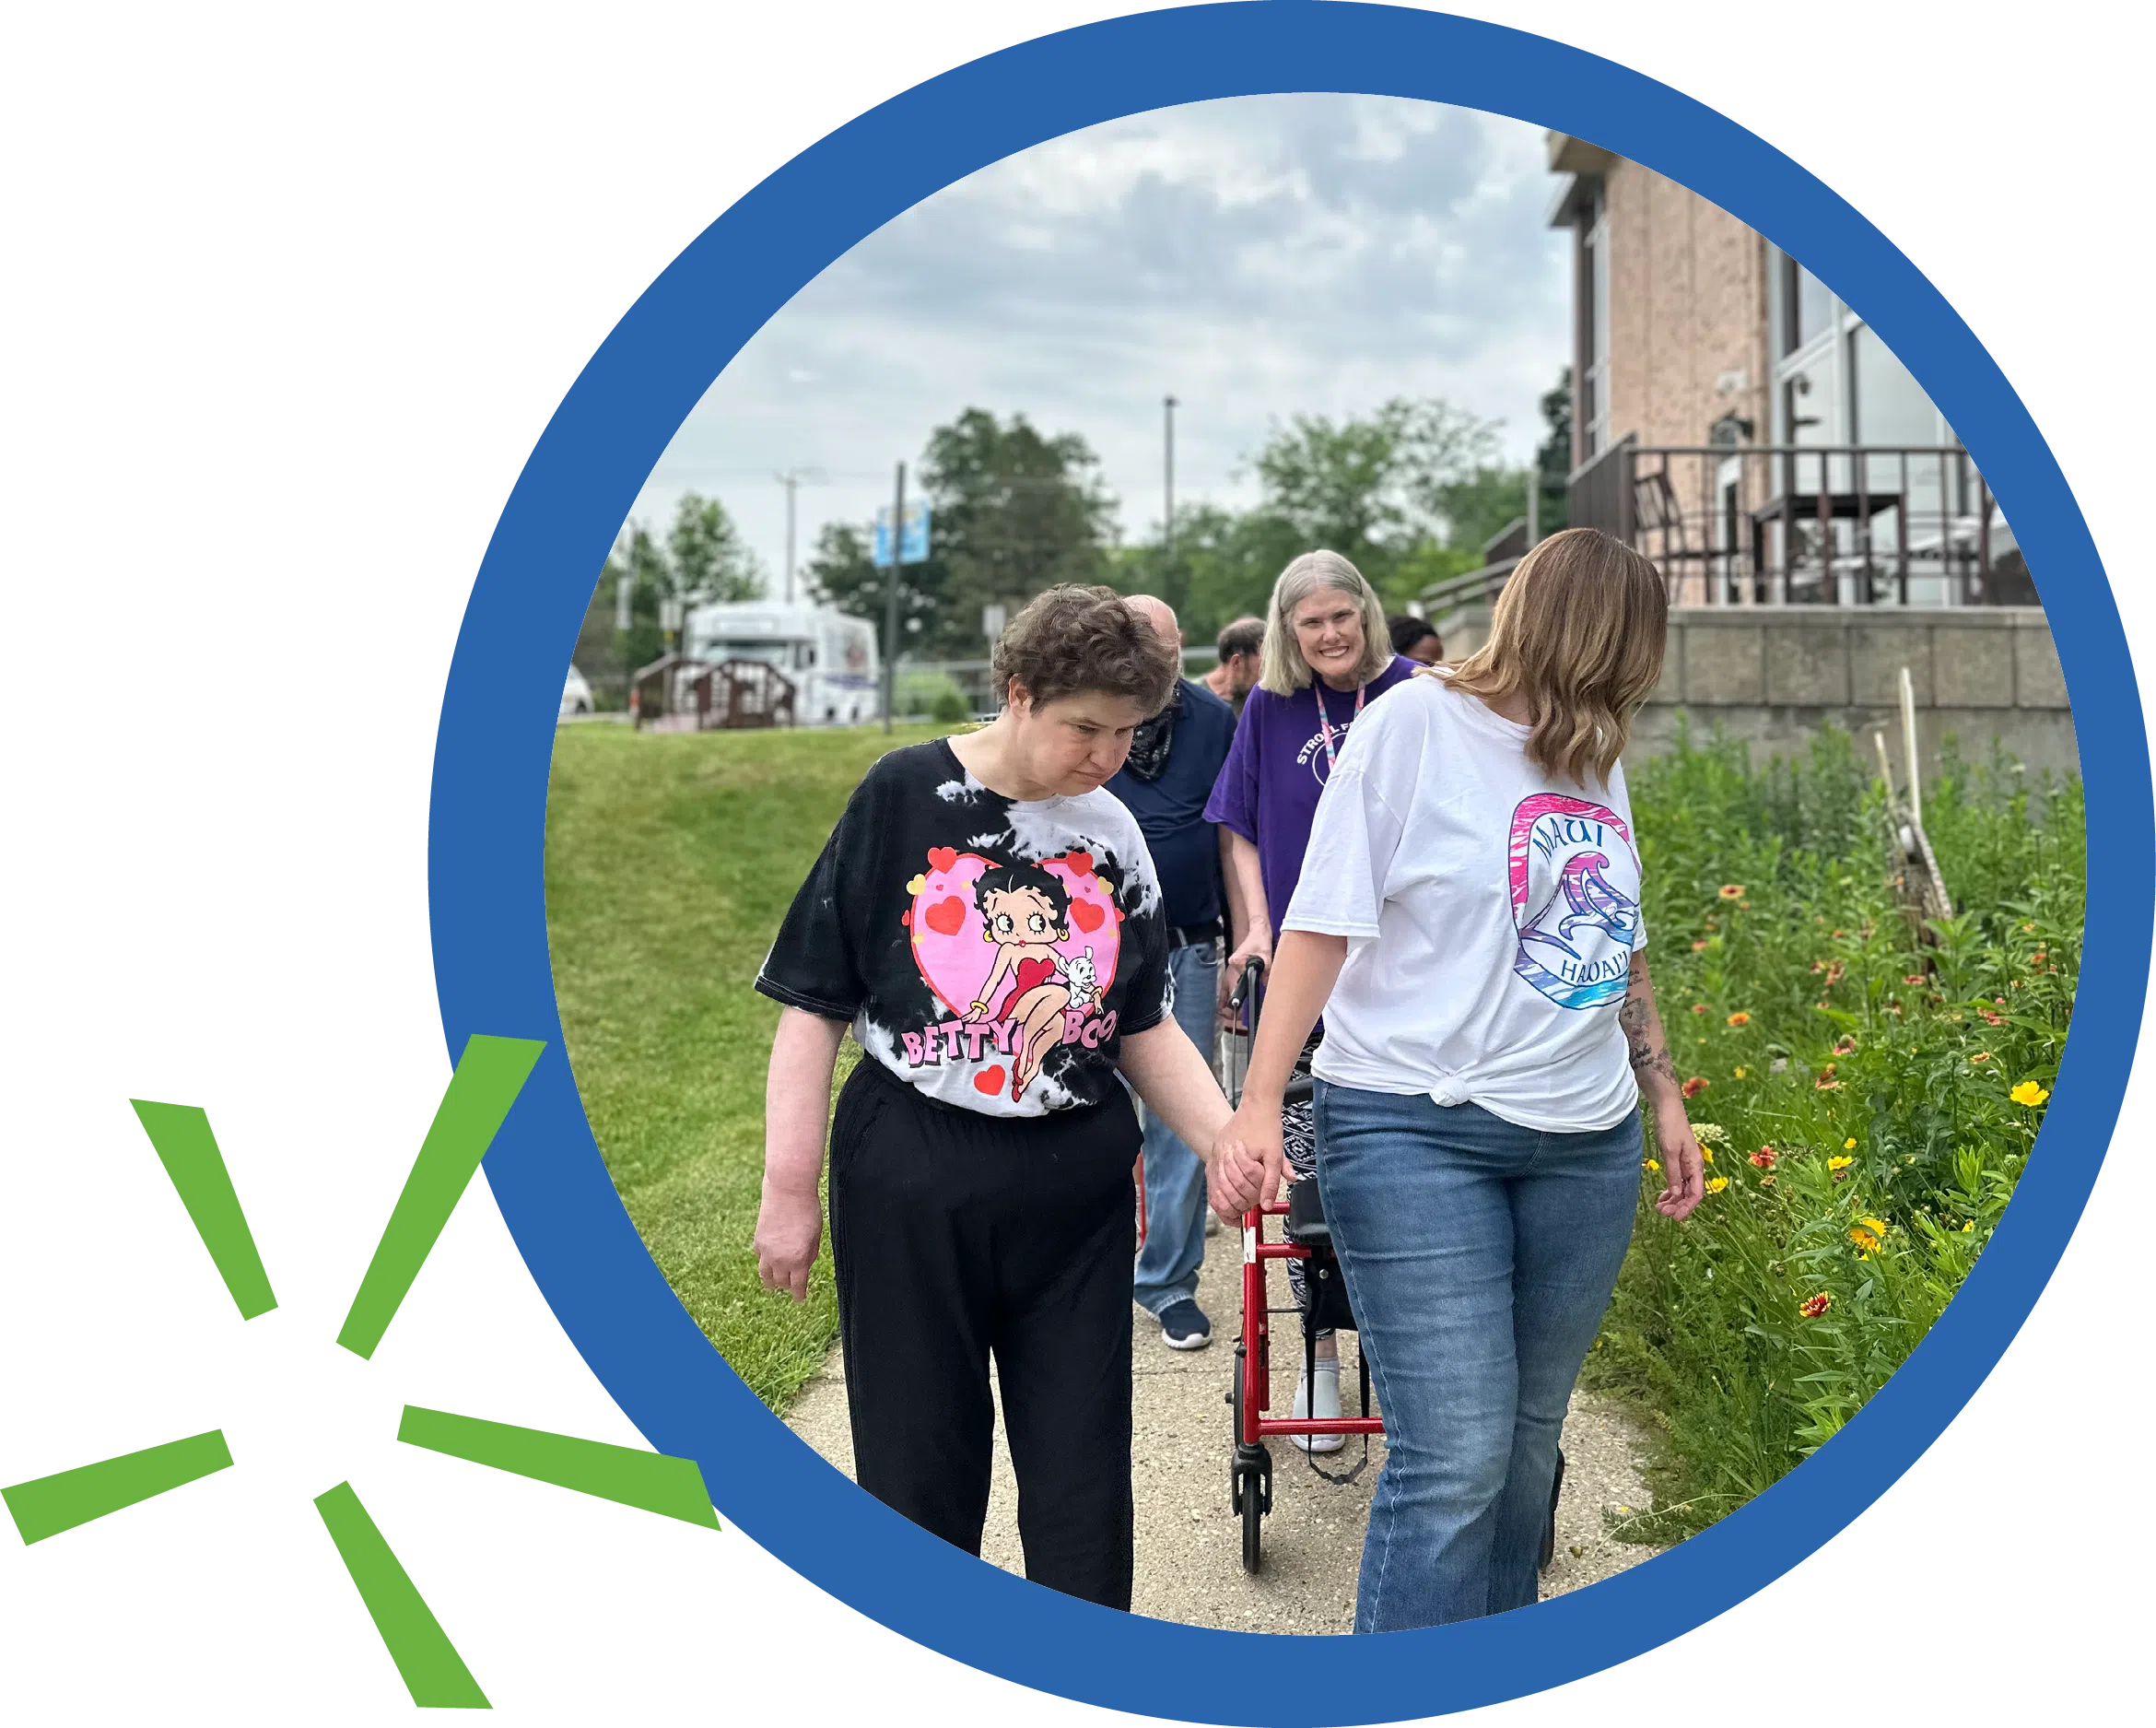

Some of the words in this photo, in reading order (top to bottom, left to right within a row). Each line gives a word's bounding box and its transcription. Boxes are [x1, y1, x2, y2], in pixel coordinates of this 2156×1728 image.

[1296, 725, 1340, 765] STROL
[1532, 817, 1603, 865] MAUI
[901, 1017, 1018, 1069] BETTY
[1061, 1009, 1119, 1049] BOO
